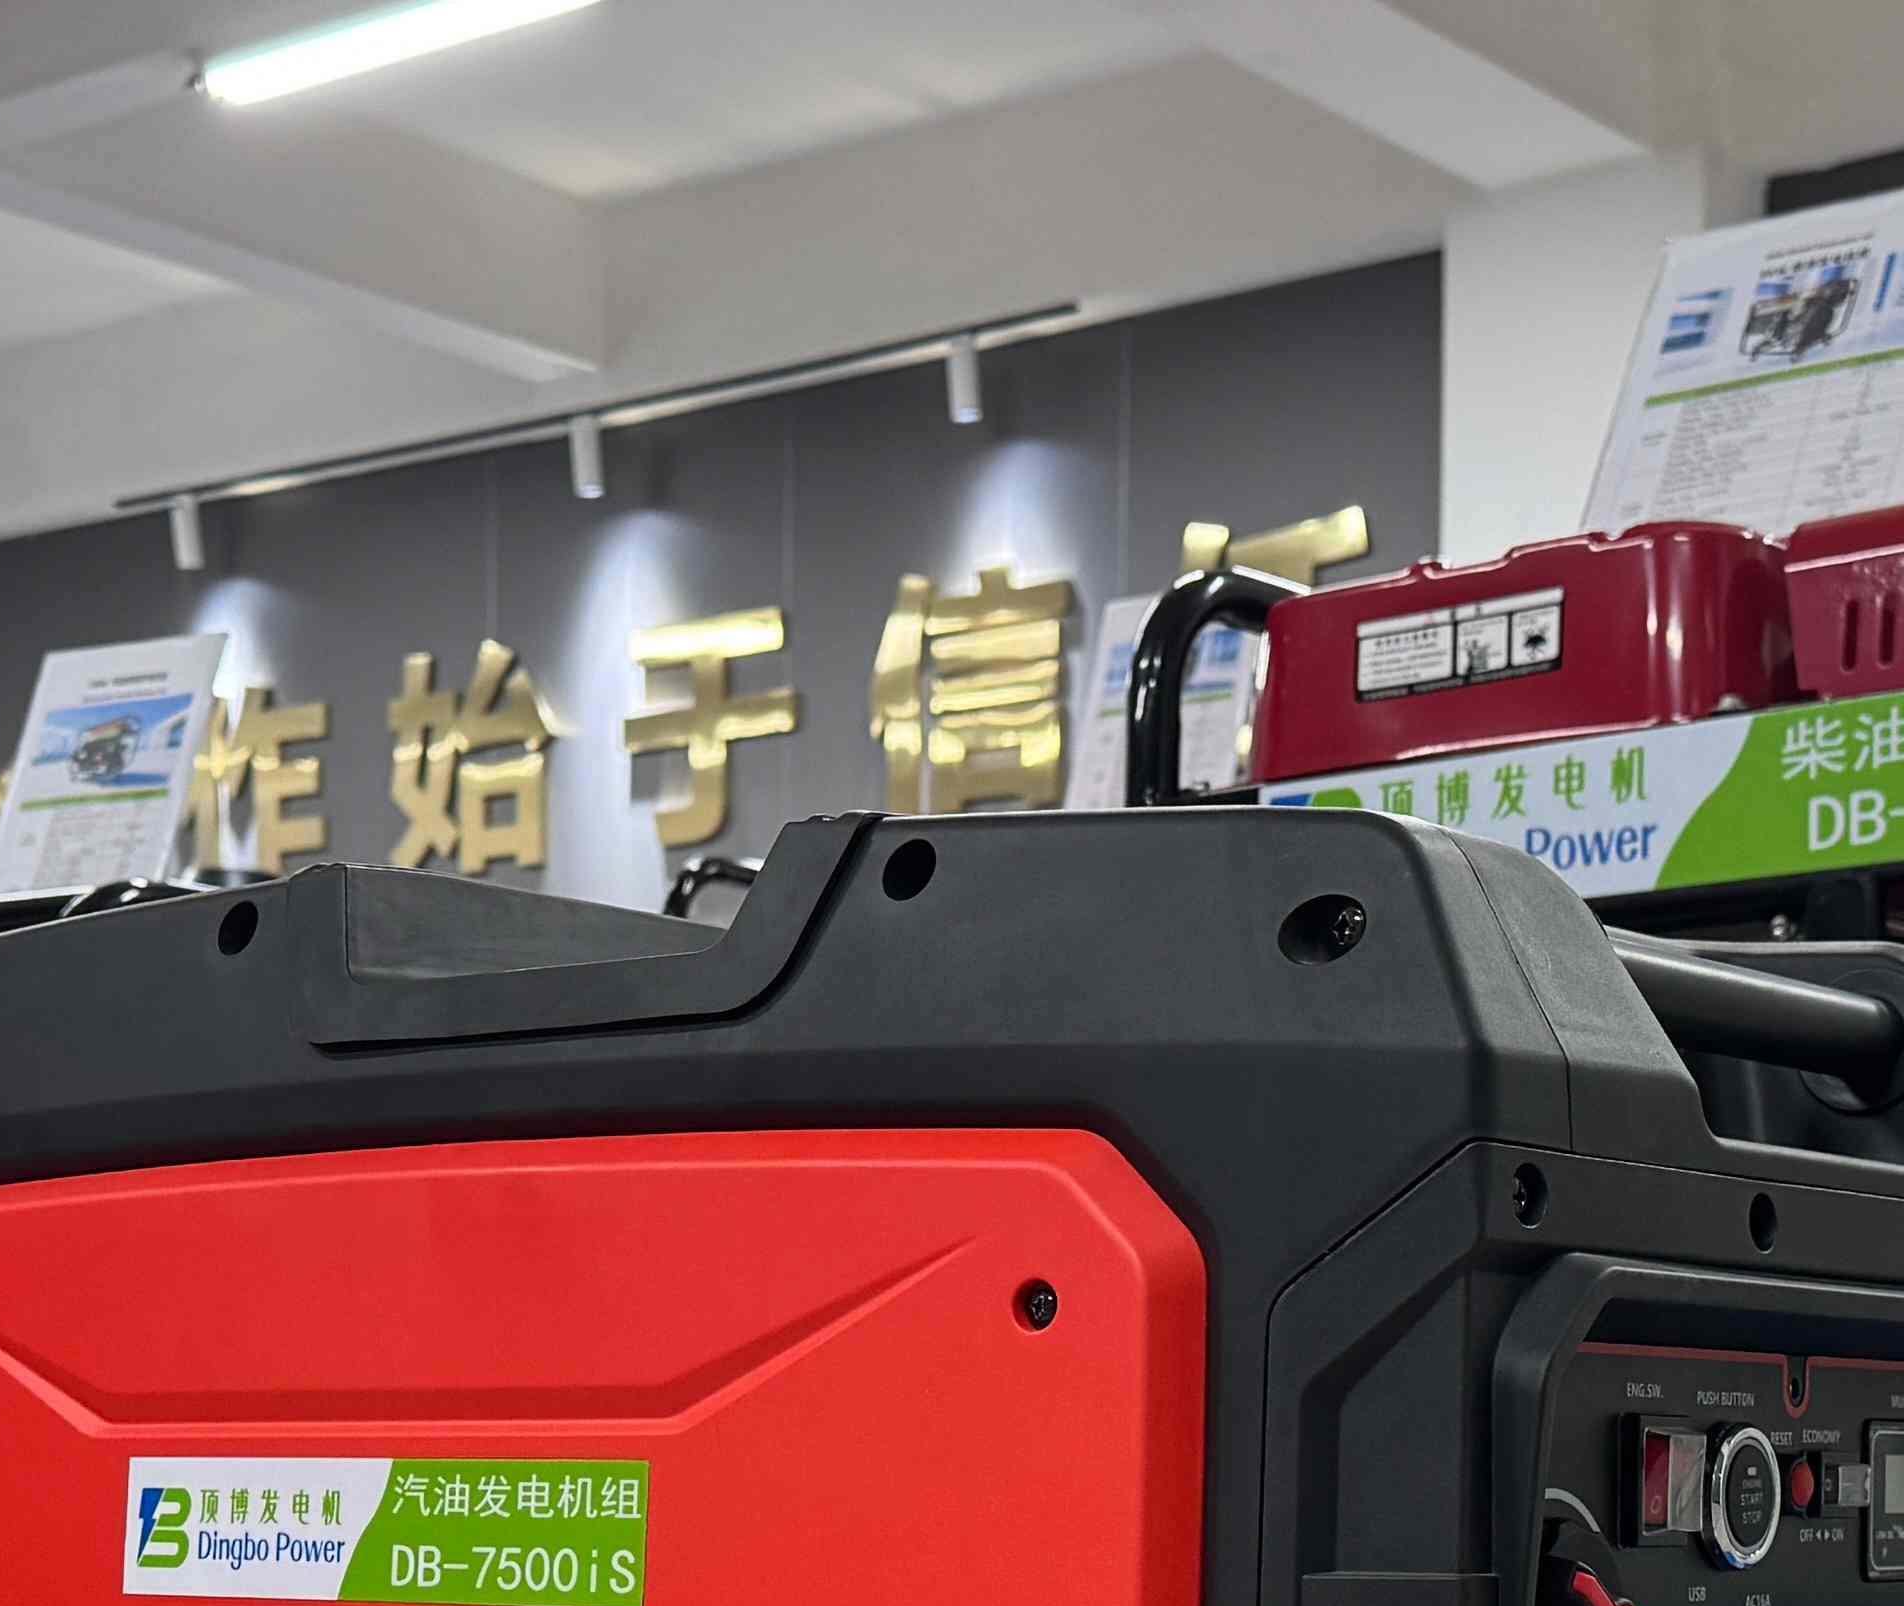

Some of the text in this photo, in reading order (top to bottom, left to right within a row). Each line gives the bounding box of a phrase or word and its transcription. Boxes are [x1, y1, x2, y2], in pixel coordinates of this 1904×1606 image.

[1380, 747, 1648, 824] 顶博发电机
[1526, 824, 1660, 871] Power
[199, 1488, 343, 1526] 顶博发电机
[393, 1472, 642, 1520] 汽油发电机组
[197, 1530, 346, 1571] Dingbo Power
[1688, 1586, 1707, 1602] USB
